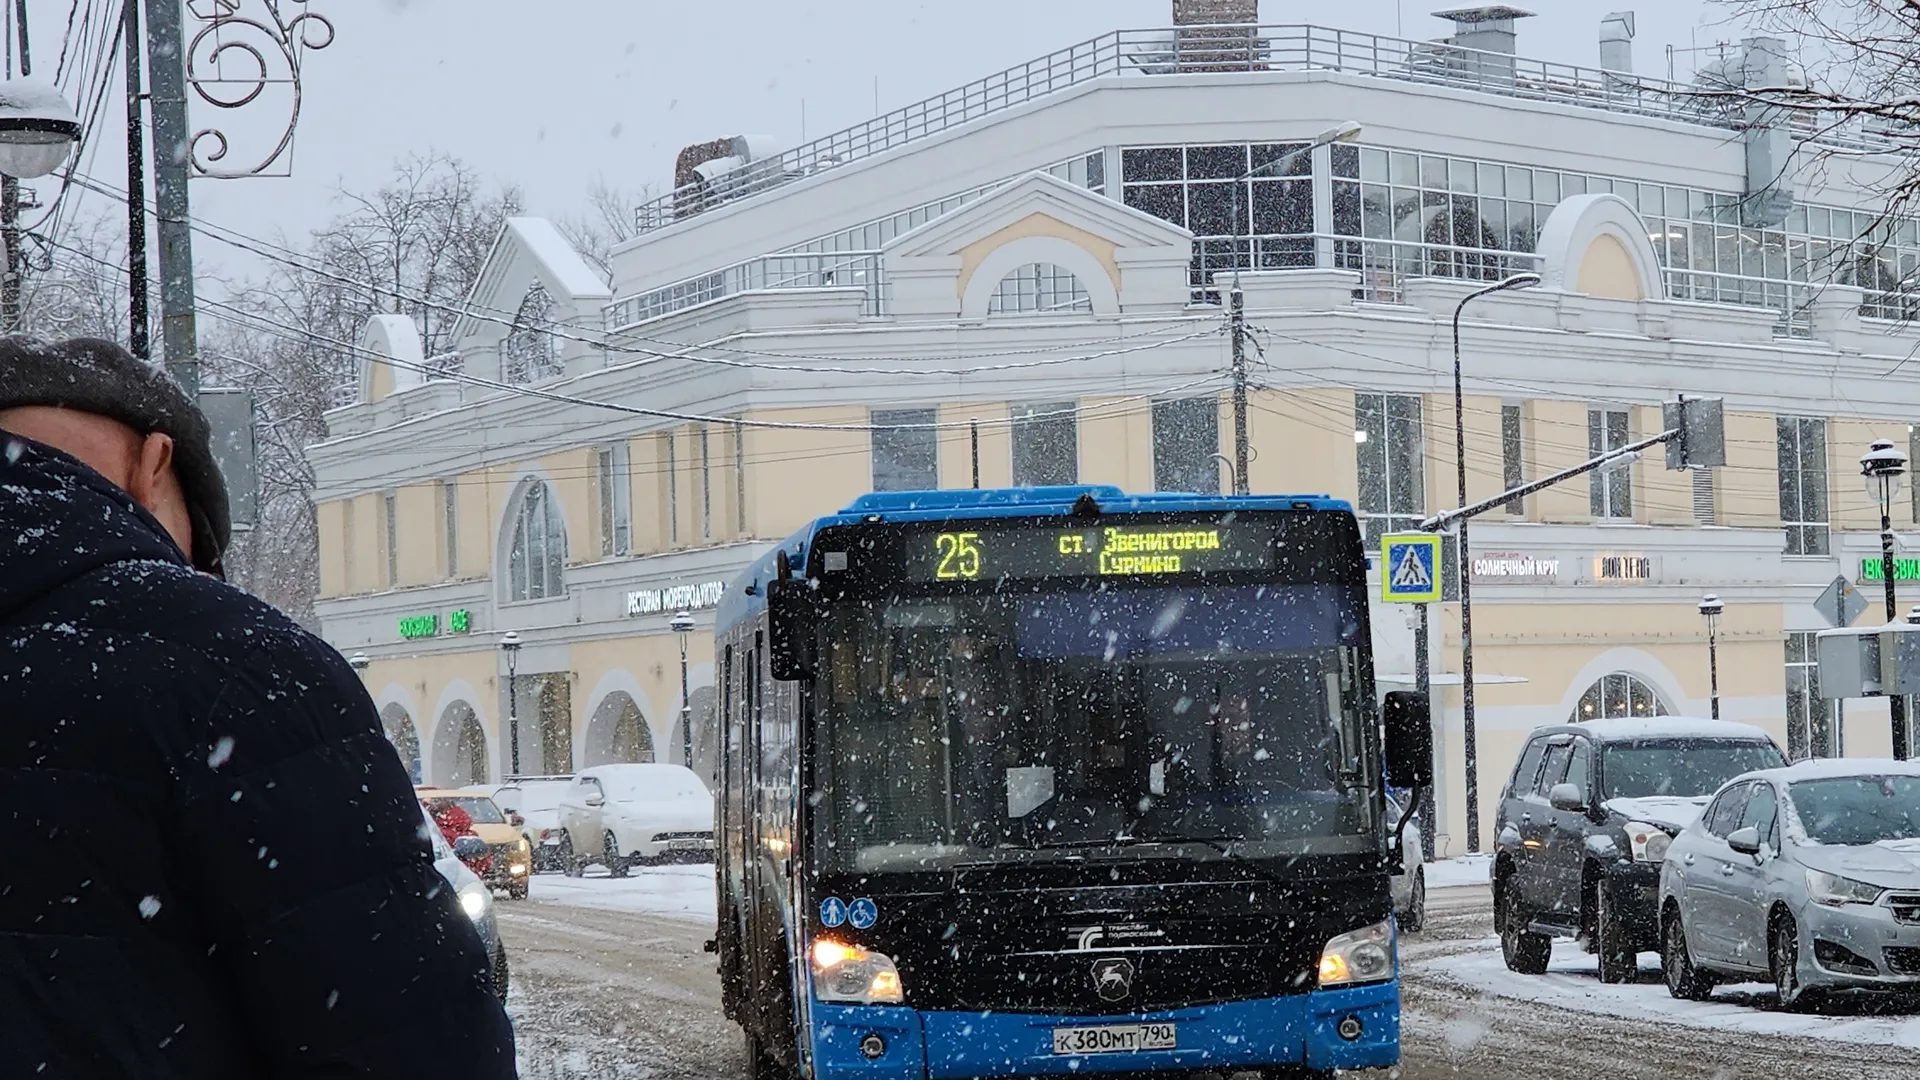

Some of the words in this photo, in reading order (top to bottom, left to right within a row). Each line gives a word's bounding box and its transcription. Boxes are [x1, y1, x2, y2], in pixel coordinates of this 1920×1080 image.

[936, 532, 981, 578] 25
[1474, 555, 1535, 576] СОЛНЕЧНЫЙ
[1536, 559, 1560, 576] КРУГ
[628, 589, 662, 614] РЕСТОРАН
[662, 581, 725, 610] МОРЕПРОДУКТОВ
